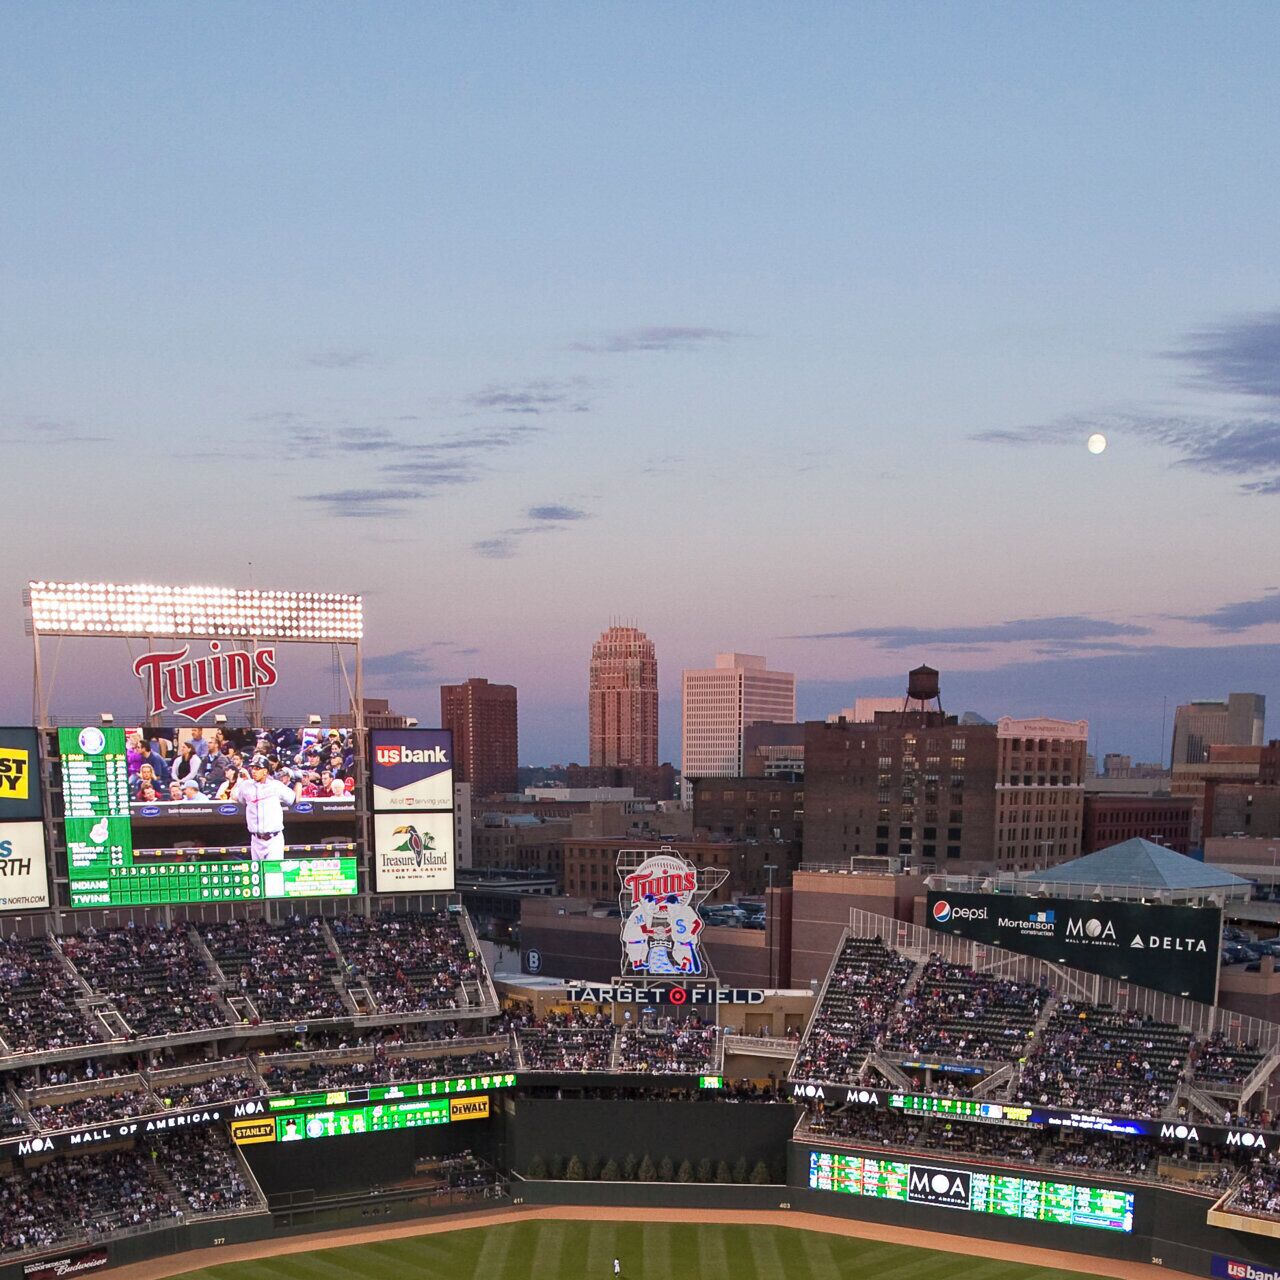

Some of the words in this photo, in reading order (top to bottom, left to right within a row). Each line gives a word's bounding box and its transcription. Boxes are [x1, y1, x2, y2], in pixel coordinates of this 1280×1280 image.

[133, 639, 278, 716] Twins
[381, 853, 415, 866] Treasure
[423, 852, 447, 866] Island
[71, 880, 108, 890] INDIANS
[625, 869, 696, 903] Twins
[72, 894, 110, 904] TWINS
[951, 907, 988, 921] pepsi
[998, 917, 1054, 930] Mortenson
[1149, 936, 1207, 952] DELTA
[567, 988, 665, 1003] TARGET
[692, 989, 765, 1004] FIELD
[71, 1130, 111, 1144] MALL
[119, 1124, 138, 1135] OF
[236, 1126, 271, 1137] STANLEY
[53, 1257, 108, 1276] Budweiser
[1152, 1257, 1163, 1265] 365
